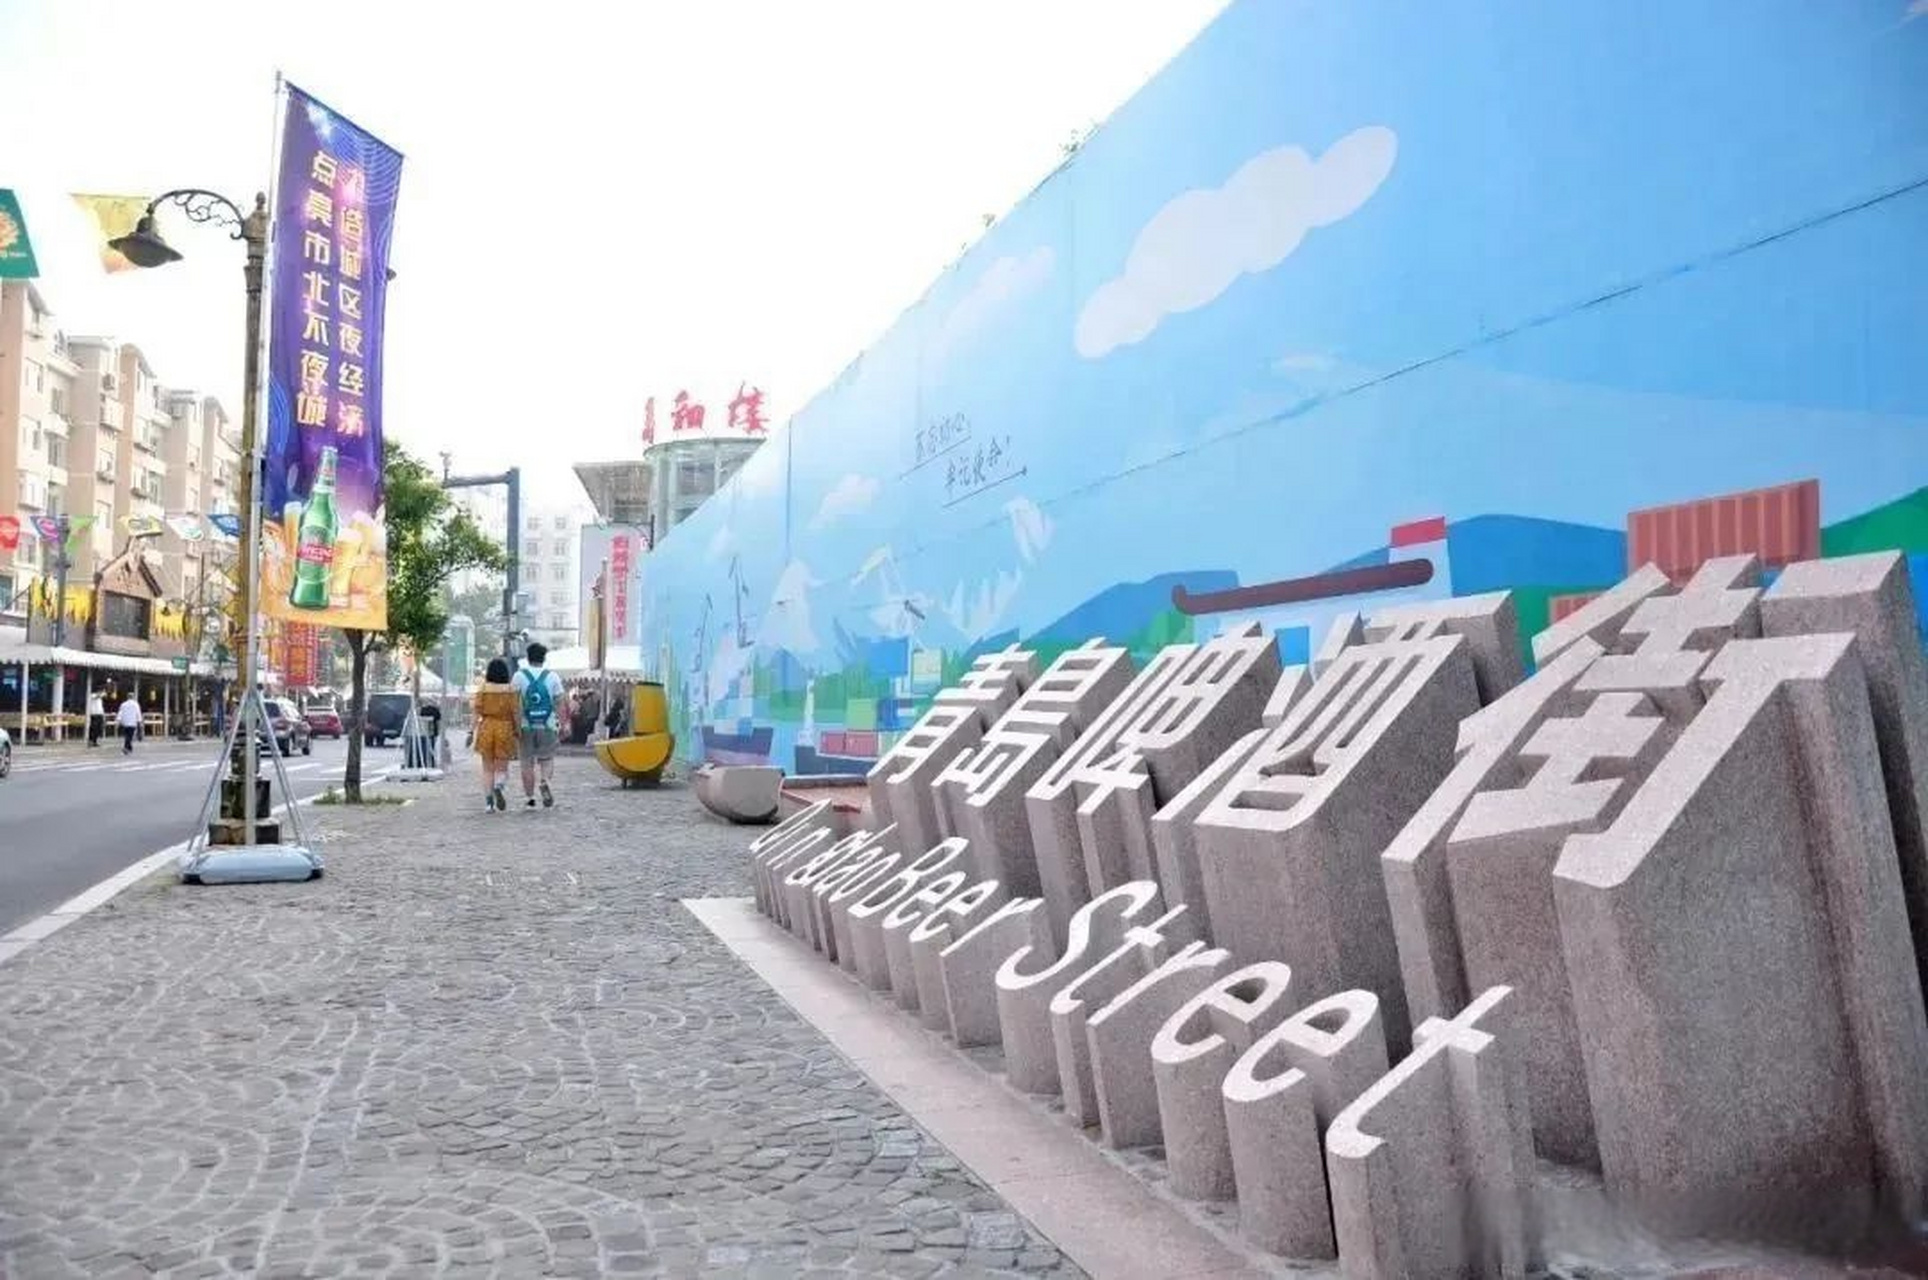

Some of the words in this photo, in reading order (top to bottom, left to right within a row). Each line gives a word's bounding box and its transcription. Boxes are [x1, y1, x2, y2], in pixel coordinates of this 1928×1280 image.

[296, 150, 338, 428] 点亮市北不夜城
[847, 836, 1045, 958] Beer
[994, 879, 1514, 1159] Street
